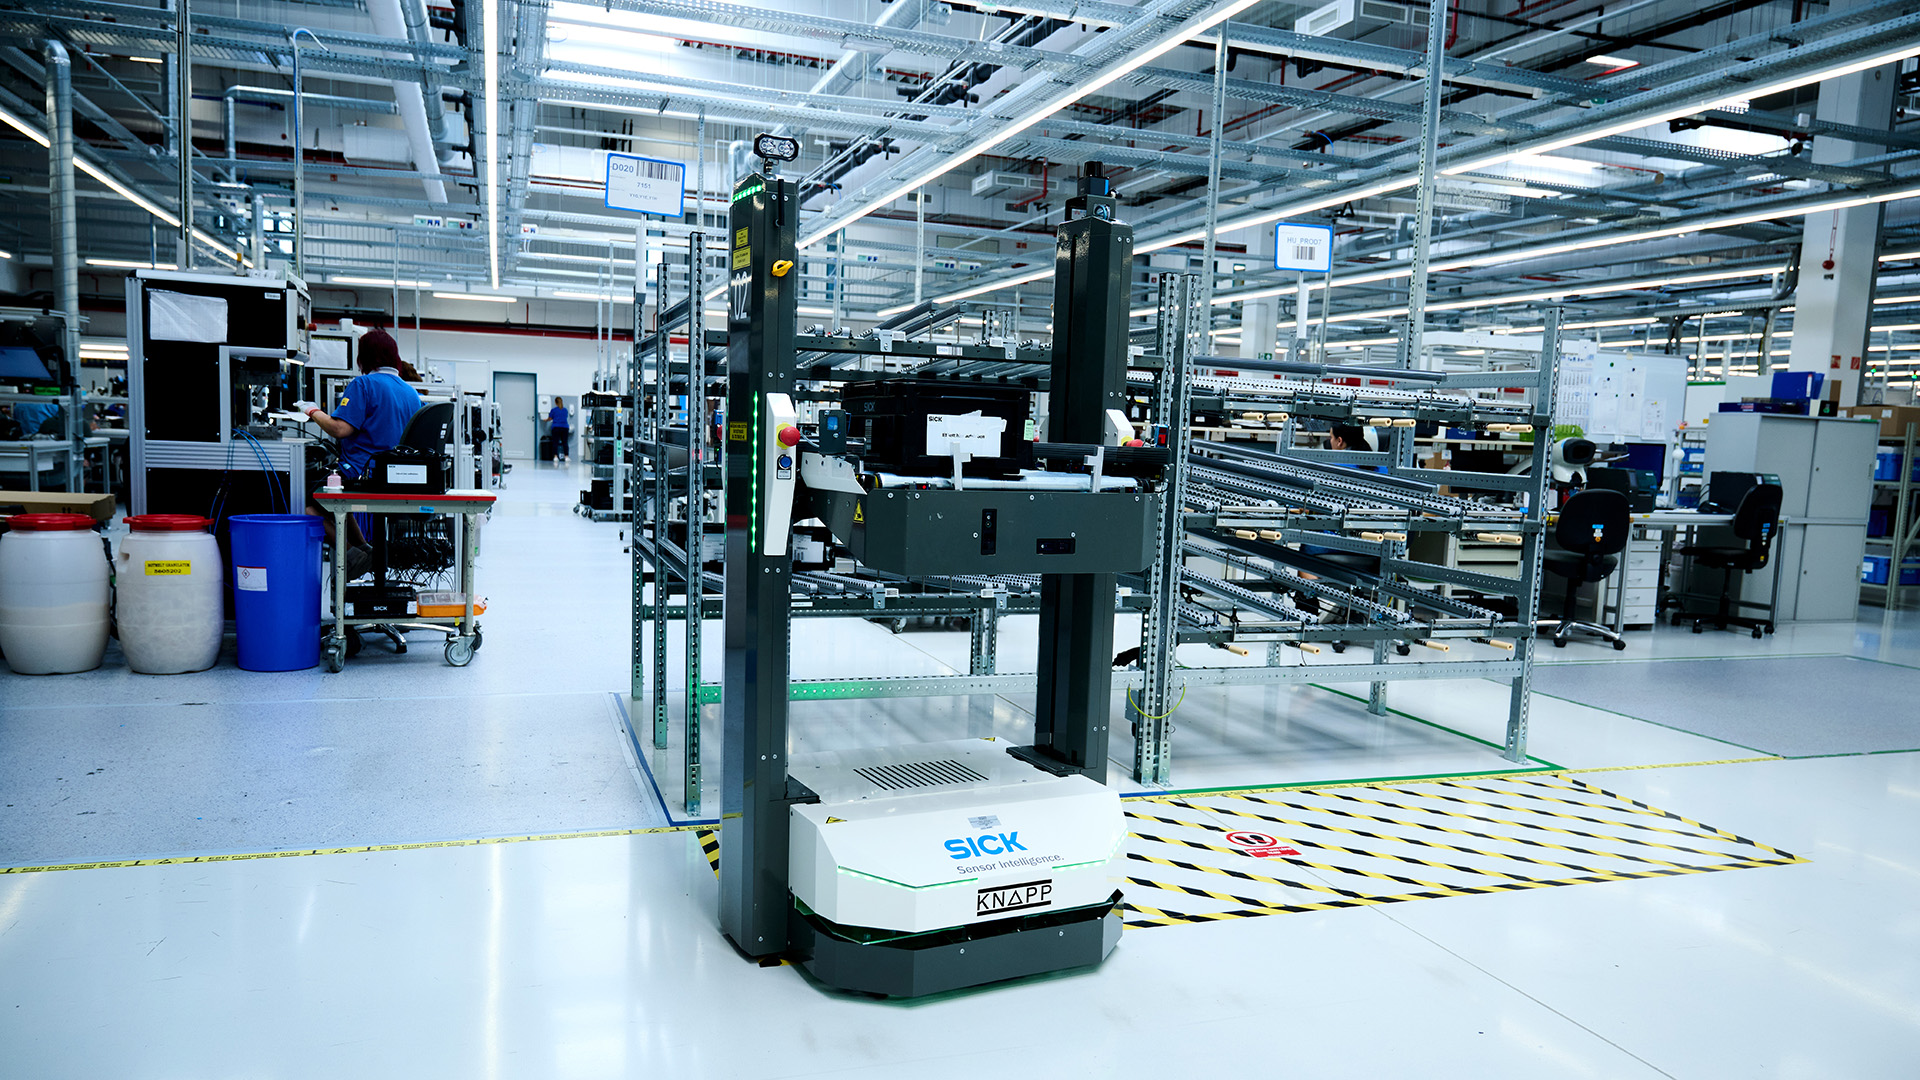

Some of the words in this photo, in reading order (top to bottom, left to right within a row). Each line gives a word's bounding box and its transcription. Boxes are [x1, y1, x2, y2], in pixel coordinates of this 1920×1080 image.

[611, 162, 634, 173] D020
[637, 181, 651, 189] 7151
[944, 831, 1028, 859] SICK
[956, 863, 997, 874] Sensor
[999, 854, 1065, 868] Intelligence.
[977, 885, 1052, 911] KNAPP
